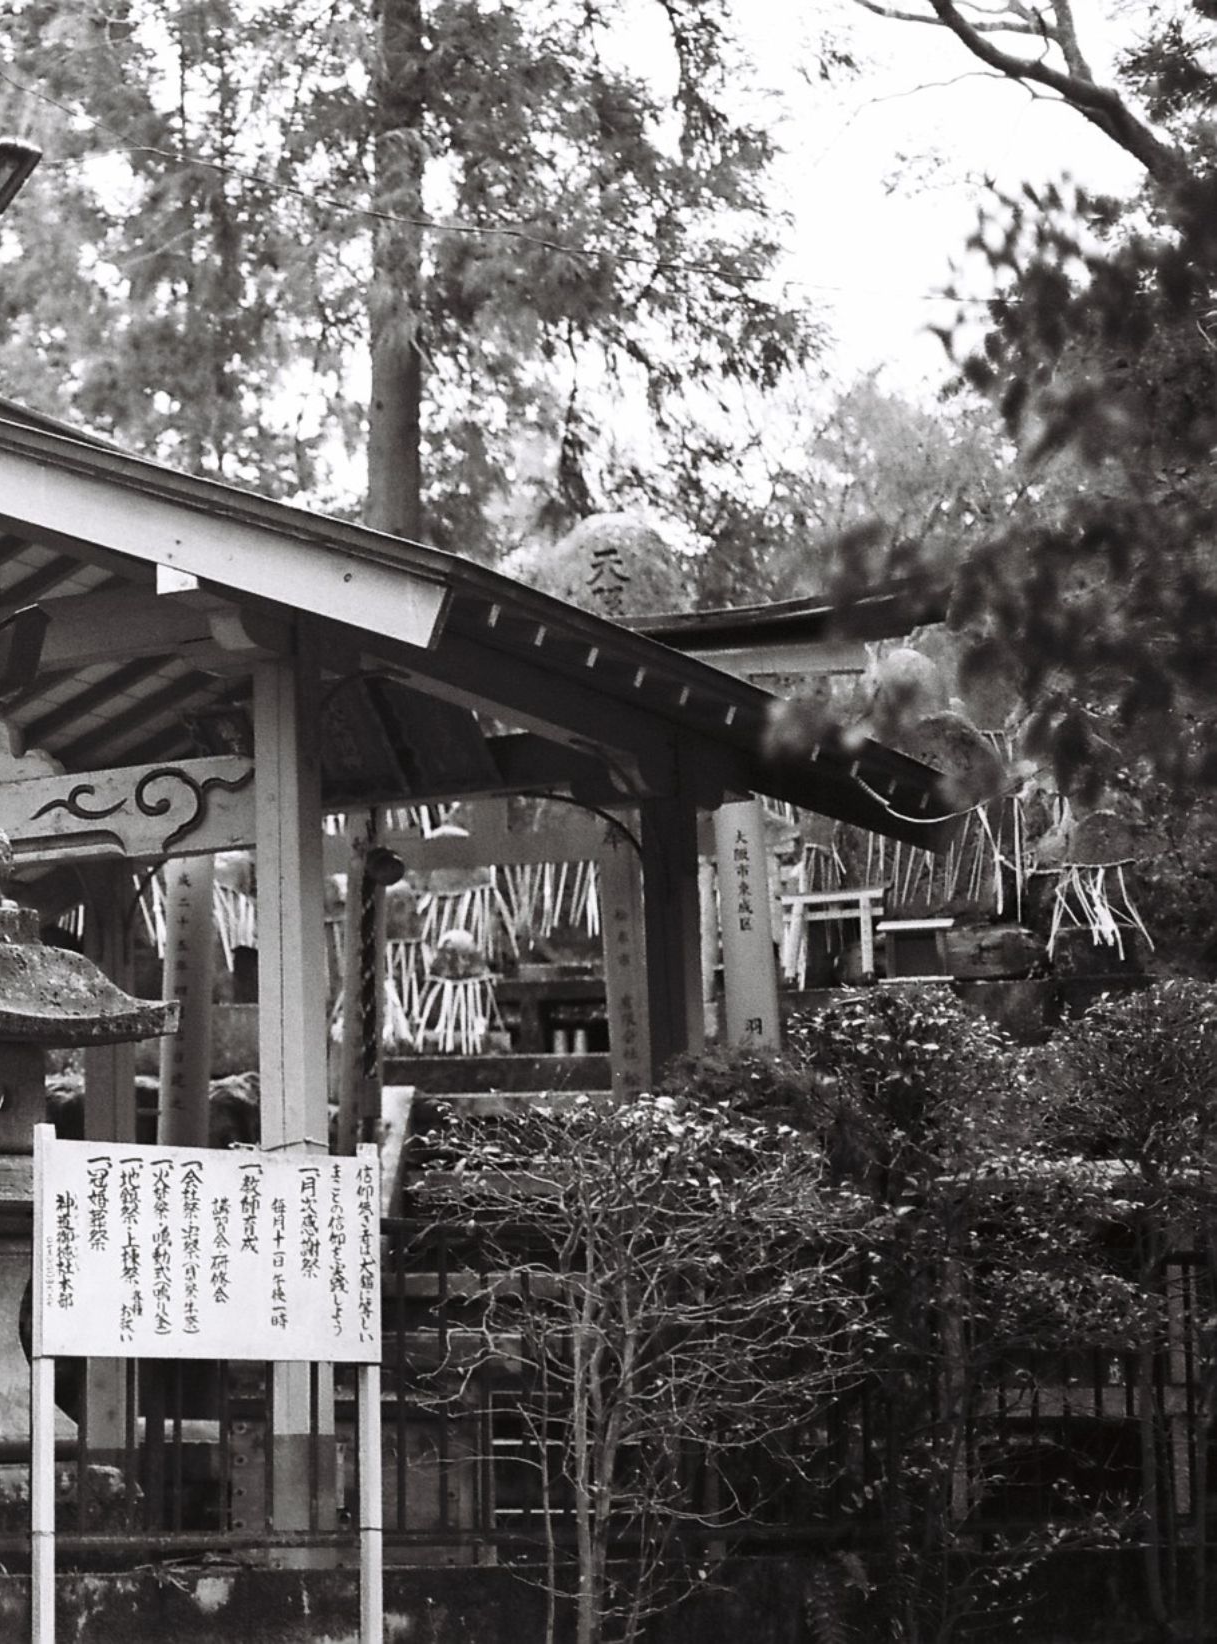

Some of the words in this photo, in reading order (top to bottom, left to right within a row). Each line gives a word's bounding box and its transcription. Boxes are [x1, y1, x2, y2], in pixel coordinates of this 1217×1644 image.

[734, 829, 754, 931] 大阪市東成区
